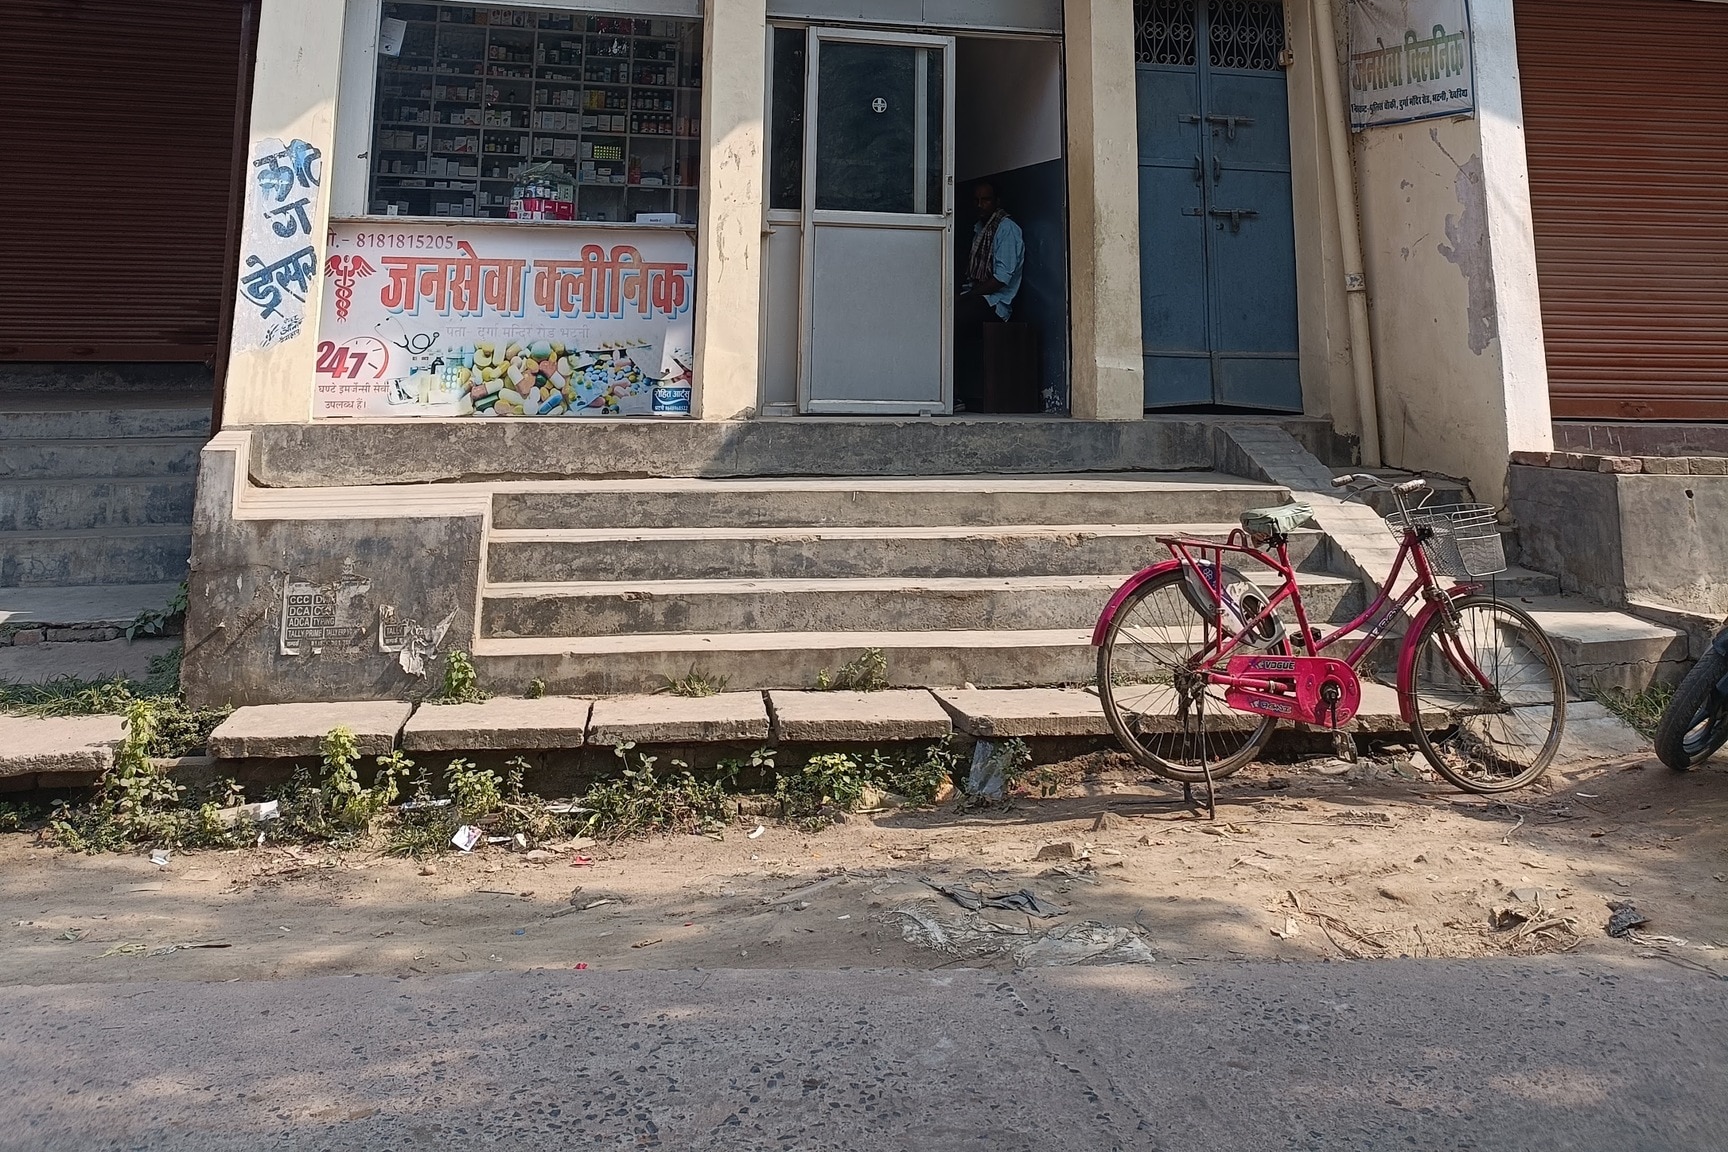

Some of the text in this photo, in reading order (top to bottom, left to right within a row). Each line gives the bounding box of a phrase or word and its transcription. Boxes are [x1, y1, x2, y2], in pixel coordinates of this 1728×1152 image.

[1351, 37, 1403, 92] जनसेवा
[356, 232, 454, 250] 8181815205
[380, 240, 689, 315] जनसेवा क्लीनिक
[289, 595, 310, 604] CCC
[289, 606, 310, 616] DCA
[288, 617, 310, 627] ADCA
[1264, 660, 1296, 670] VOGUE
